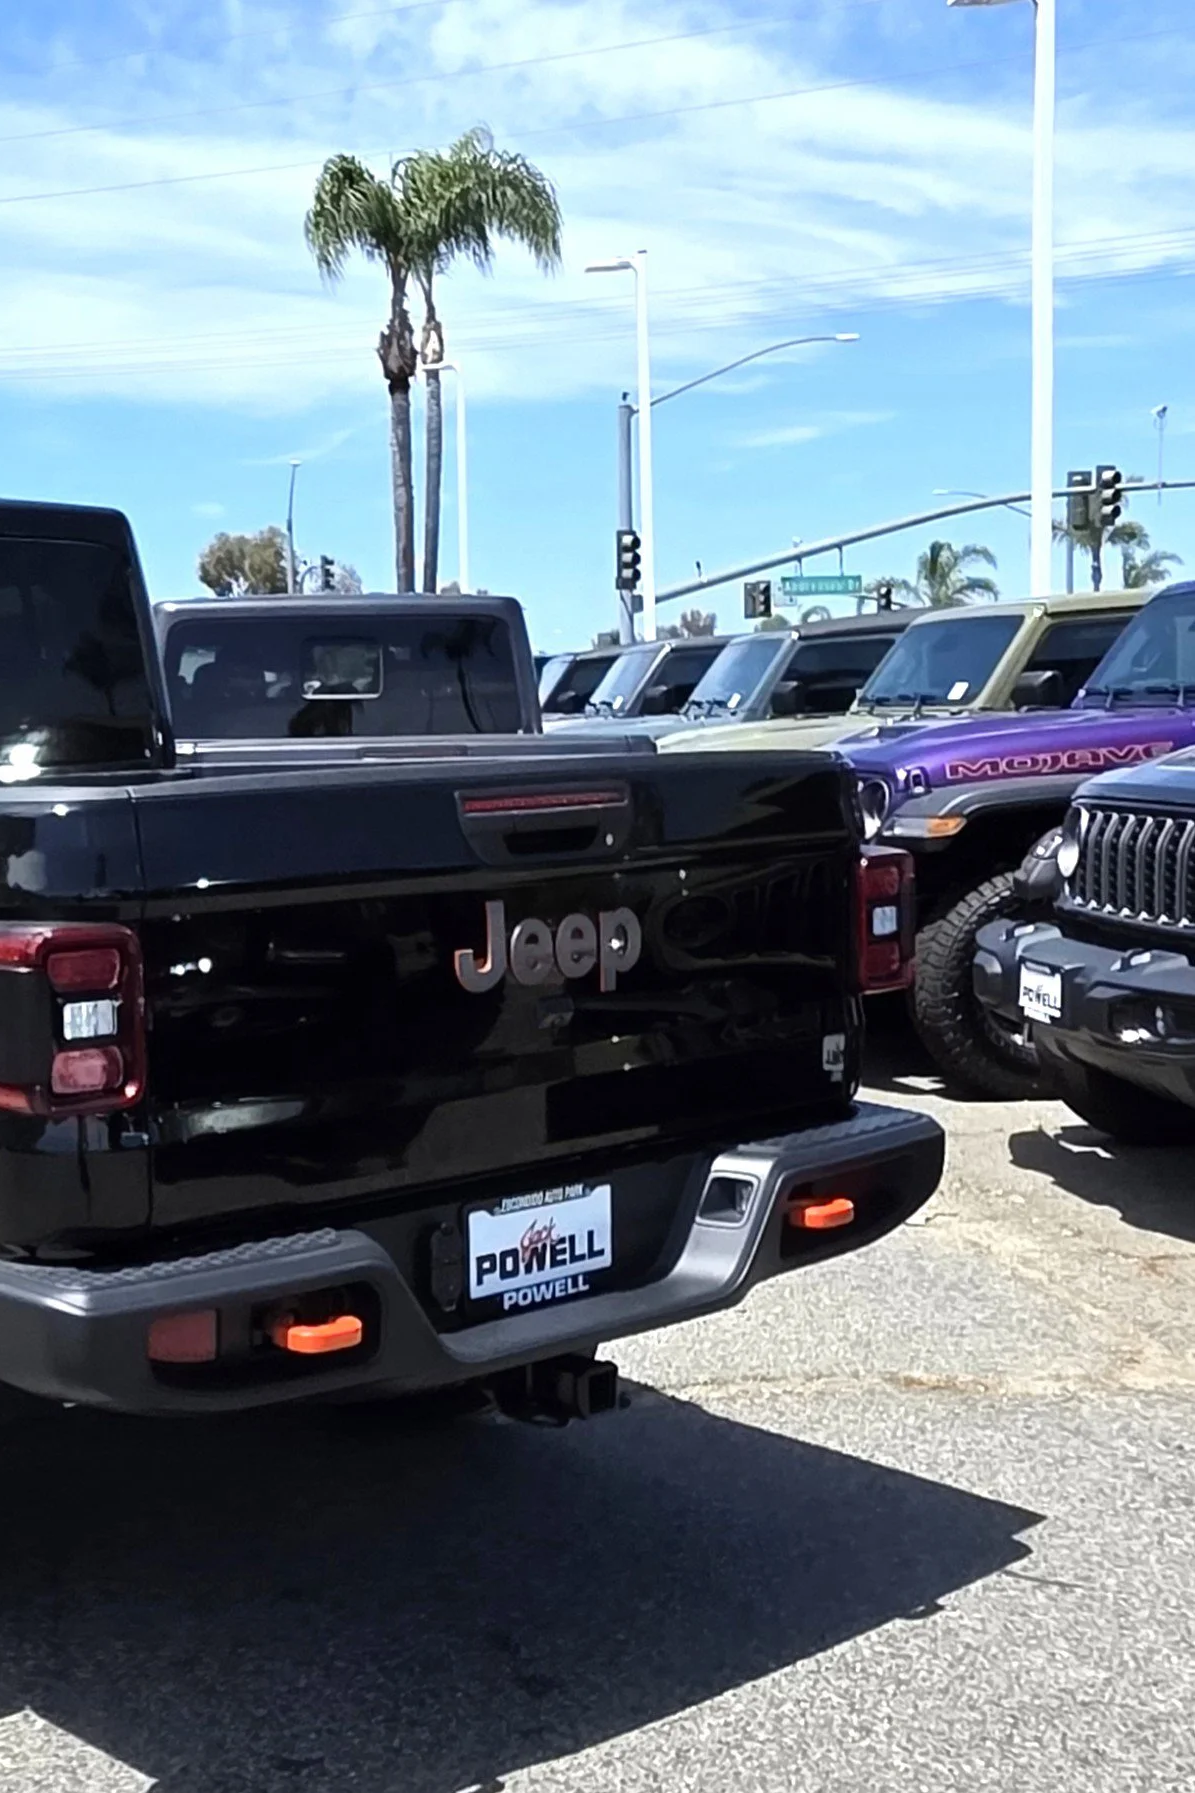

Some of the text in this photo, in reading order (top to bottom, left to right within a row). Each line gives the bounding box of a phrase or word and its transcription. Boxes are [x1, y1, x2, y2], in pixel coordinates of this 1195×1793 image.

[455, 900, 642, 994] Jeep
[475, 1229, 605, 1286] POWELL
[520, 1215, 561, 1263] Jack
[503, 1275, 590, 1311] POWELL
